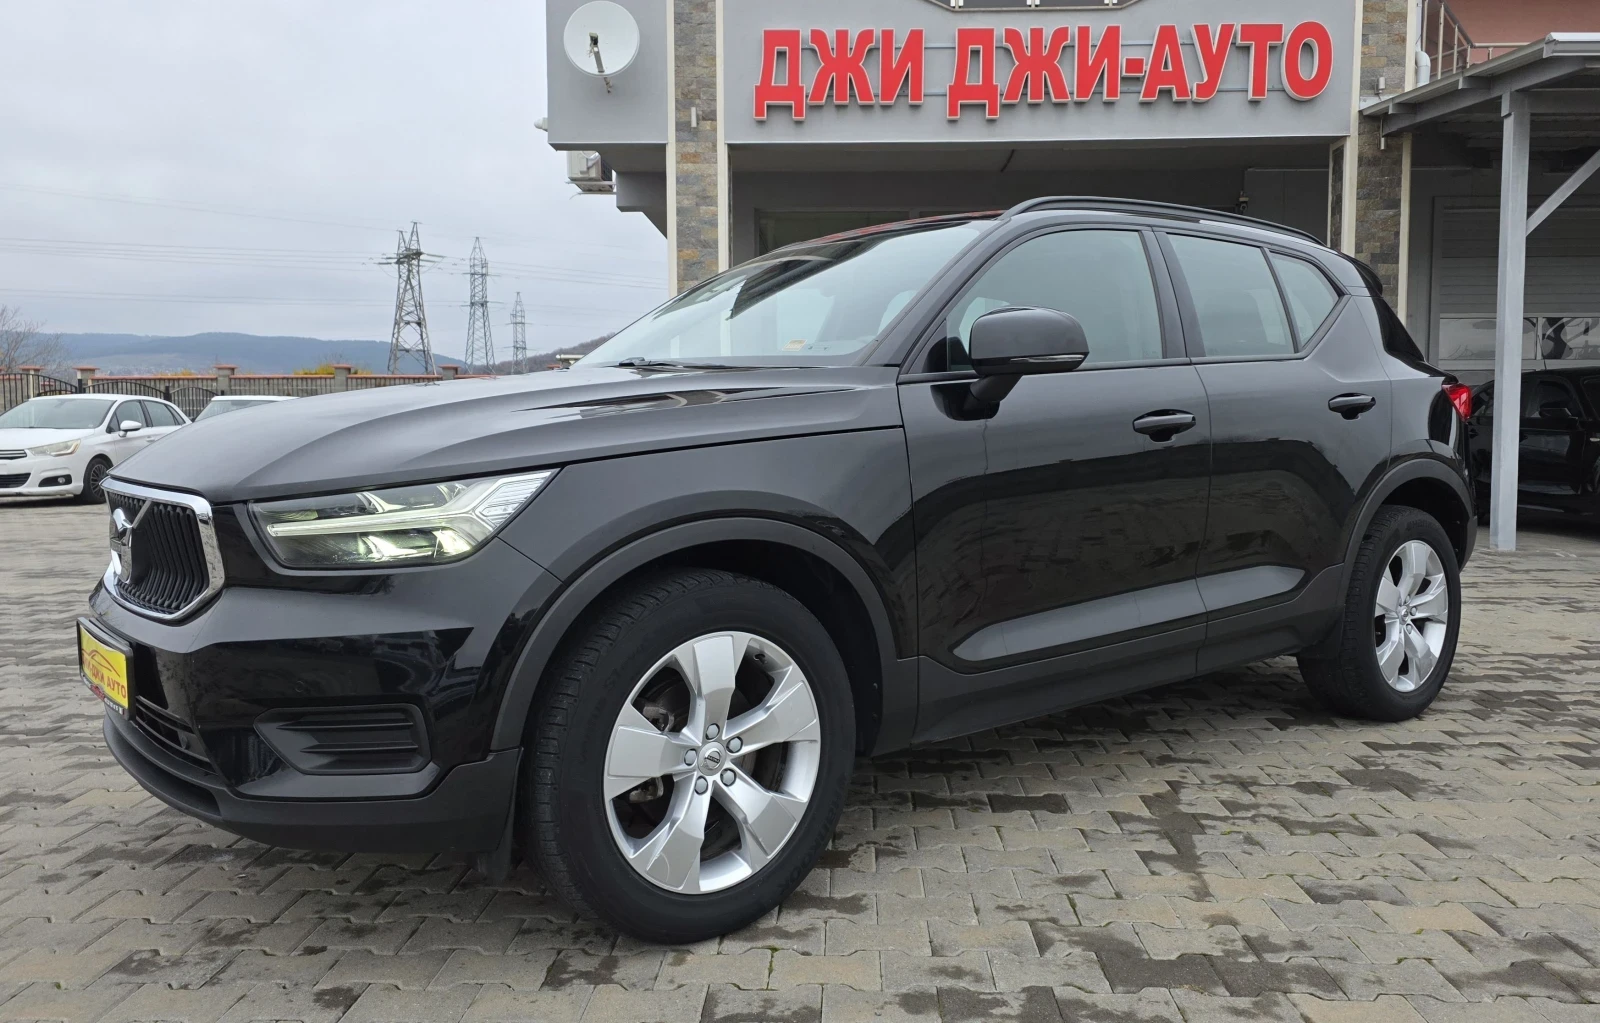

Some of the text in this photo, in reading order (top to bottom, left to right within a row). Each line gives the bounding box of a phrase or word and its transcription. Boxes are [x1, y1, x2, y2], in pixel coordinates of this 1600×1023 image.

[753, 20, 1334, 121] ДЖИ ДЖИ-АУТО
[107, 675, 127, 699] АУТО
